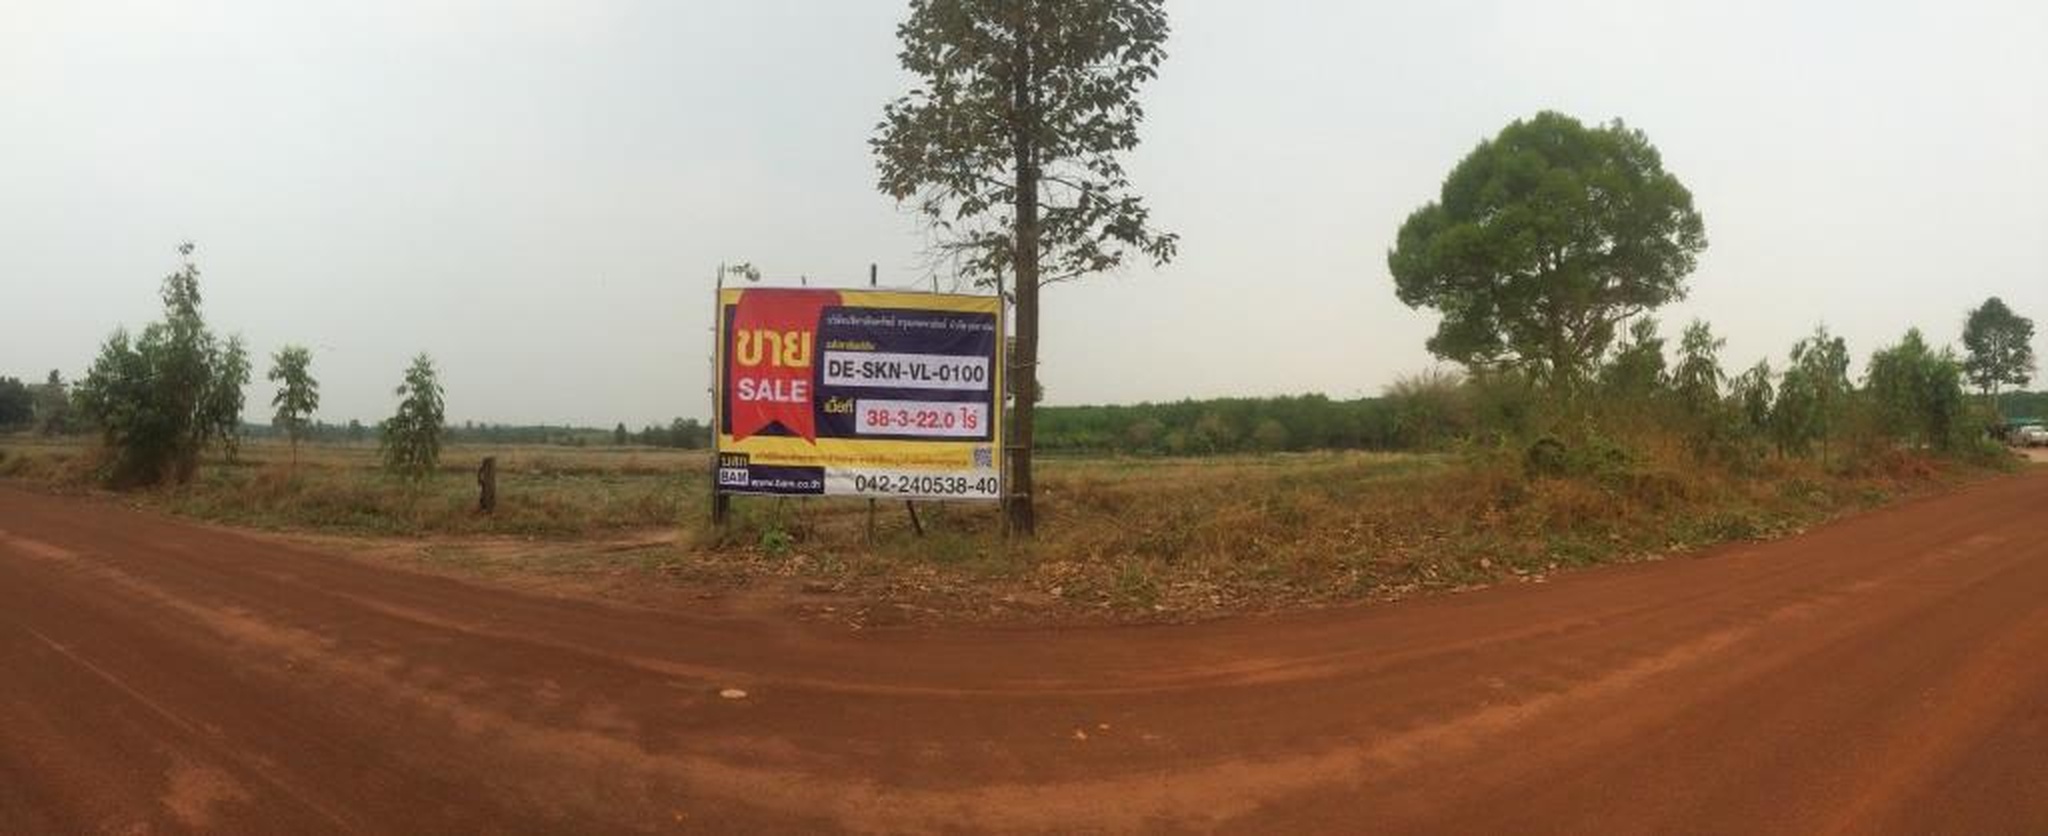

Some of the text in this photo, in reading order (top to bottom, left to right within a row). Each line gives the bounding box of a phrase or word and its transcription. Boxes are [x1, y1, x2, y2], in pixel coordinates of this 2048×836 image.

[737, 329, 811, 367] ขาย
[828, 360, 984, 382] DE-SKN-VL-0100
[738, 378, 808, 402] SALE
[866, 406, 977, 430] 38-3-22.0 ไร่
[855, 474, 998, 494] 042-240538-40
